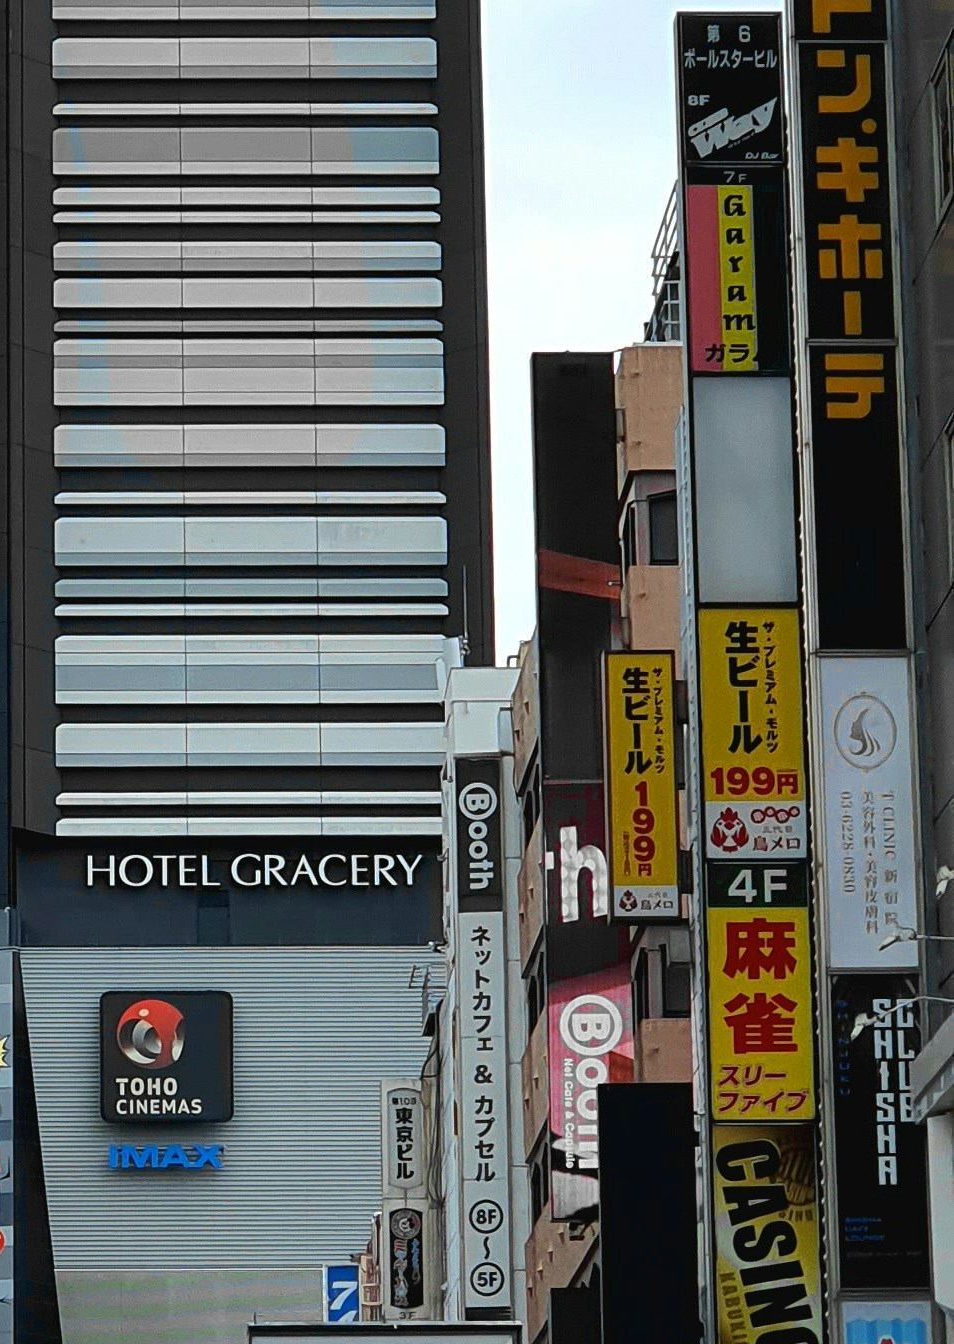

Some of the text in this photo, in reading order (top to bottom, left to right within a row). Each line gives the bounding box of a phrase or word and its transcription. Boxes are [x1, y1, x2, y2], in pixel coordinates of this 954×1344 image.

[687, 94, 710, 106] 8F
[724, 170, 747, 184] 7F
[723, 194, 756, 331] Garam
[705, 343, 757, 363] ガラ
[621, 666, 653, 776] 生ビール
[724, 620, 763, 755] 生ビール
[761, 620, 780, 755] ザ・プレミアム・モルツ
[709, 765, 799, 797] 199円
[458, 782, 498, 891] Booth
[631, 779, 656, 878] 199円
[86, 853, 423, 887] HOTEL GRACERY
[727, 868, 788, 904] 4F
[470, 926, 494, 1052] ネットカフェ
[723, 918, 799, 1055] 麻雀
[115, 1099, 203, 1116] CINEMAS
[116, 1077, 178, 1096] TOHO
[718, 1065, 788, 1087] スリー
[718, 1088, 811, 1115] ファイブ
[872, 998, 898, 1186] SHISHA
[108, 1143, 225, 1171] IMAX
[395, 1107, 415, 1180] 東京ビル
[472, 1093, 496, 1183] カプセル
[476, 1209, 498, 1289] 8F 5F
